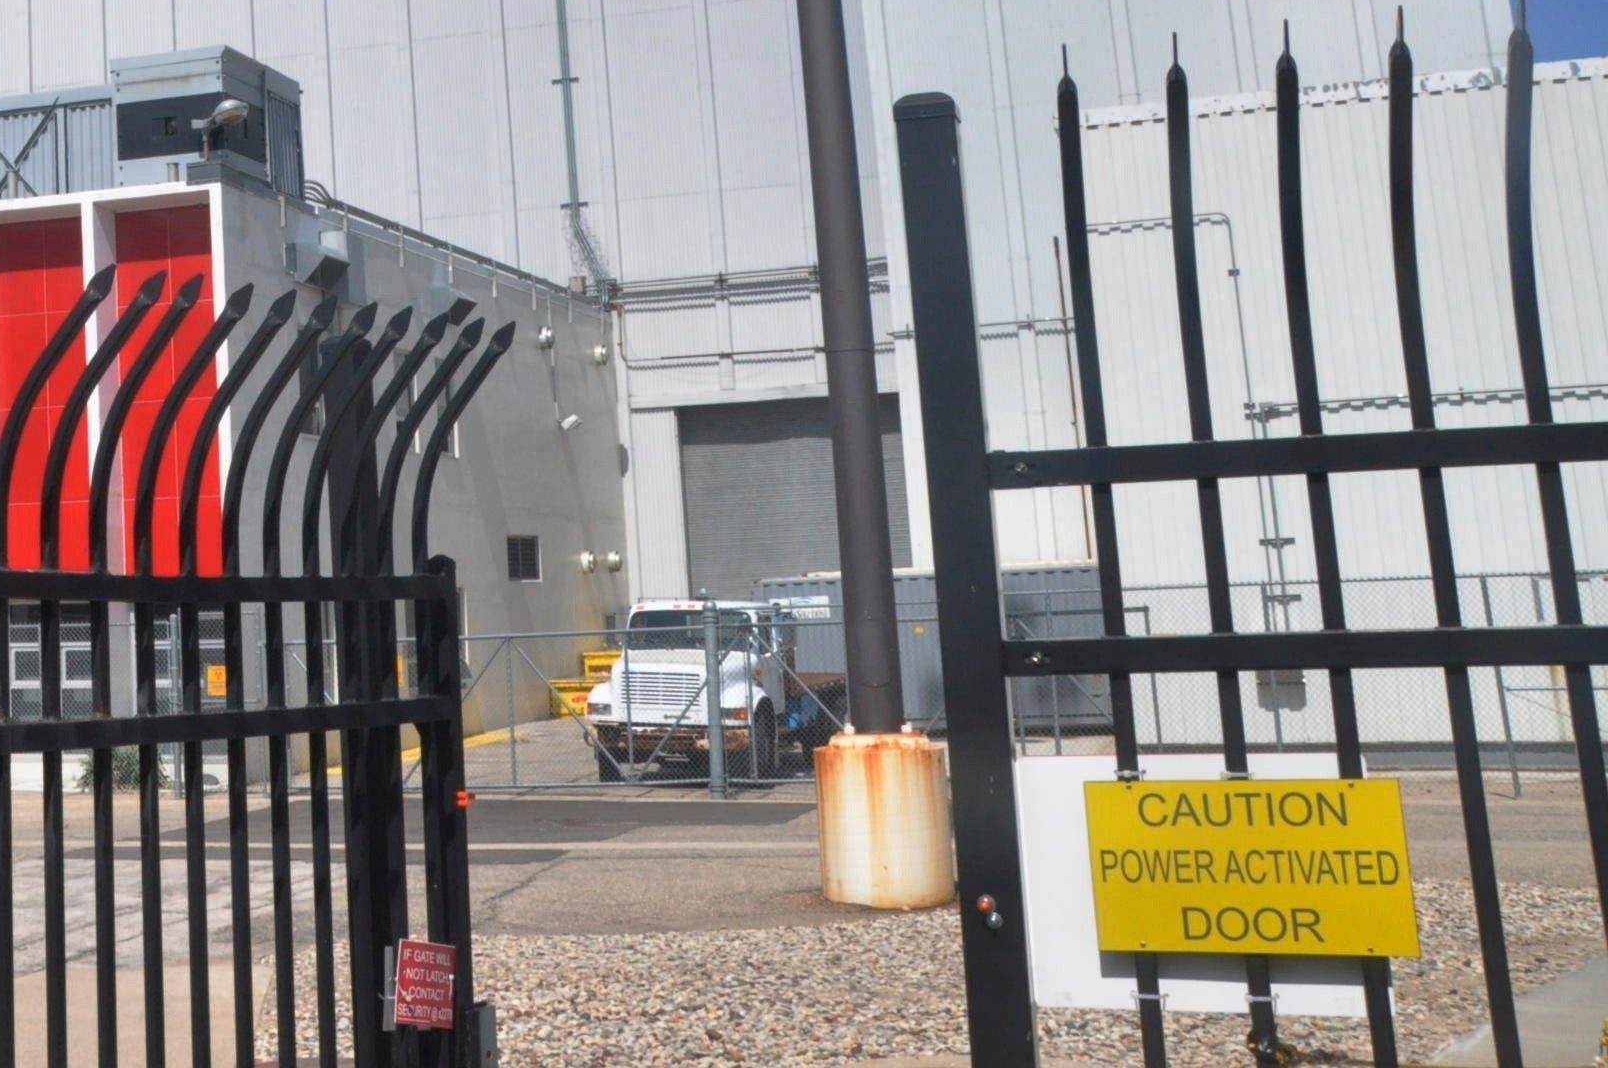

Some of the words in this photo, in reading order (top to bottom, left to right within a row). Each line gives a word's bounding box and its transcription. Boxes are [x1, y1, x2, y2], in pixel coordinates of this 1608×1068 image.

[1138, 792, 1348, 827] CAUTION
[1100, 849, 1217, 884] POWER
[1224, 850, 1399, 886] ACTIVATED
[1182, 907, 1324, 943] DOOR
[403, 948, 412, 960] IF
[414, 949, 434, 964] GATE
[436, 953, 451, 966] WILL
[405, 967, 424, 980] NOT
[409, 986, 445, 1001] CONTACT
